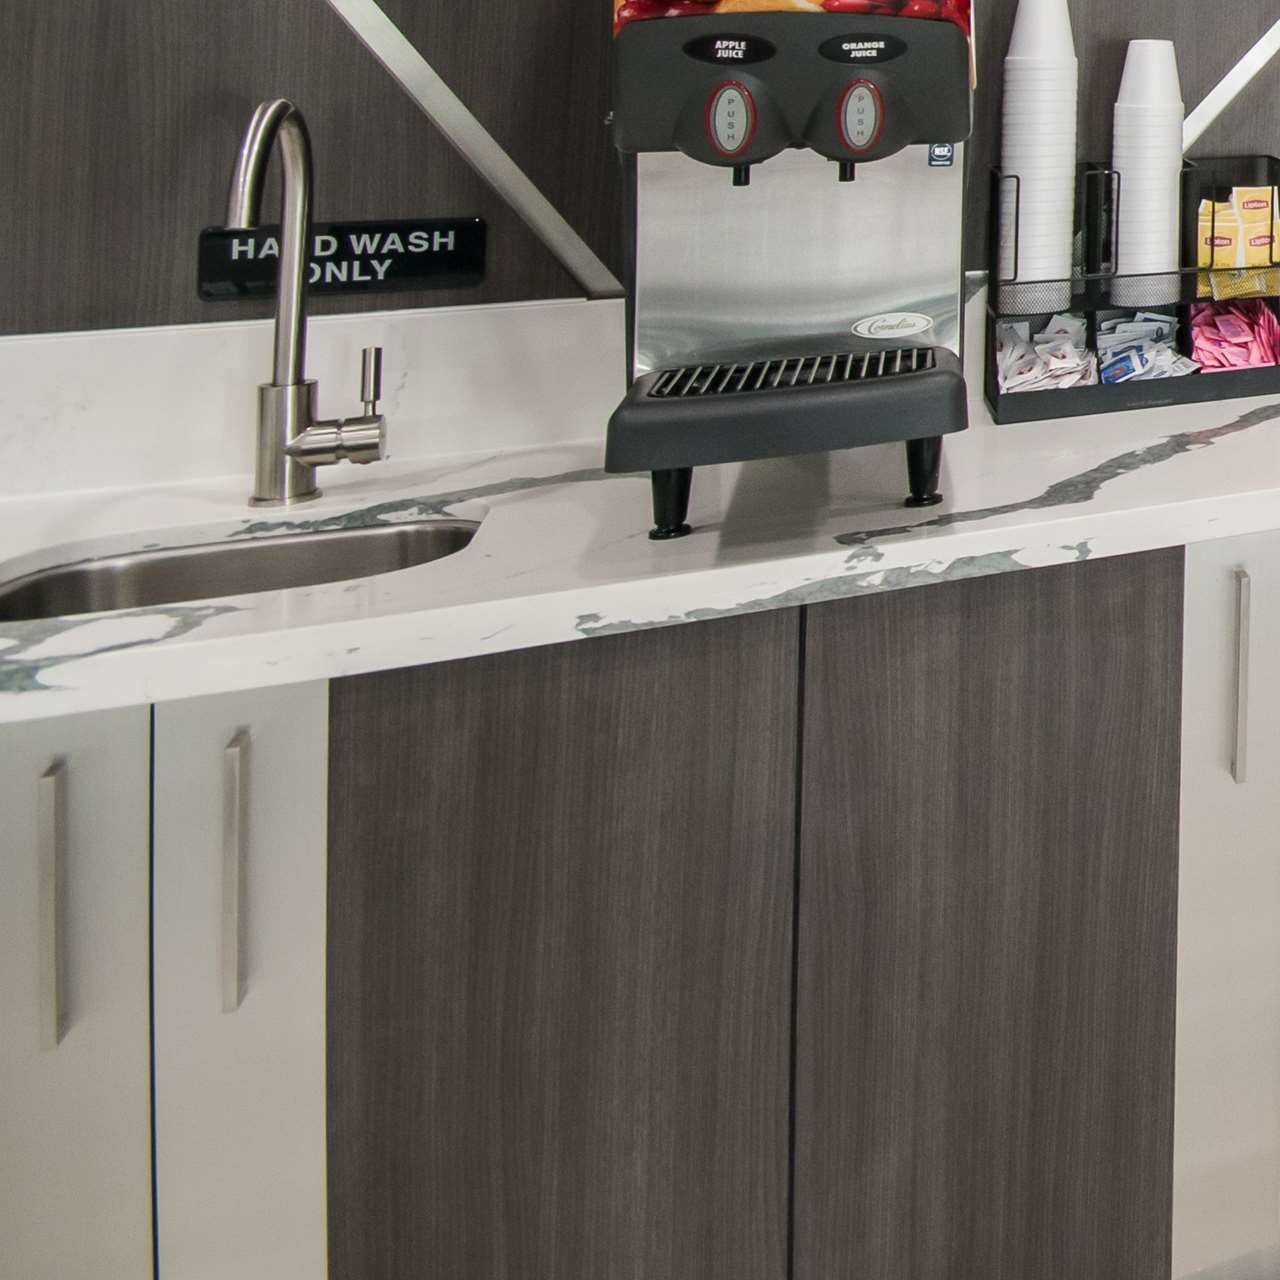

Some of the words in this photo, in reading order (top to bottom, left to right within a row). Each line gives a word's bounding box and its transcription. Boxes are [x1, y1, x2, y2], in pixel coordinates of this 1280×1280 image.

[714, 40, 747, 50] APPLE
[842, 41, 885, 50] ORANGE
[716, 49, 744, 59] JUICE
[850, 49, 877, 58] JUICE
[727, 98, 736, 142] PUSH
[856, 96, 865, 138] PUSH
[1245, 201, 1267, 209] Lipton
[231, 235, 338, 260] HAD
[350, 230, 456, 255] WASH
[1206, 237, 1230, 246] Lpton
